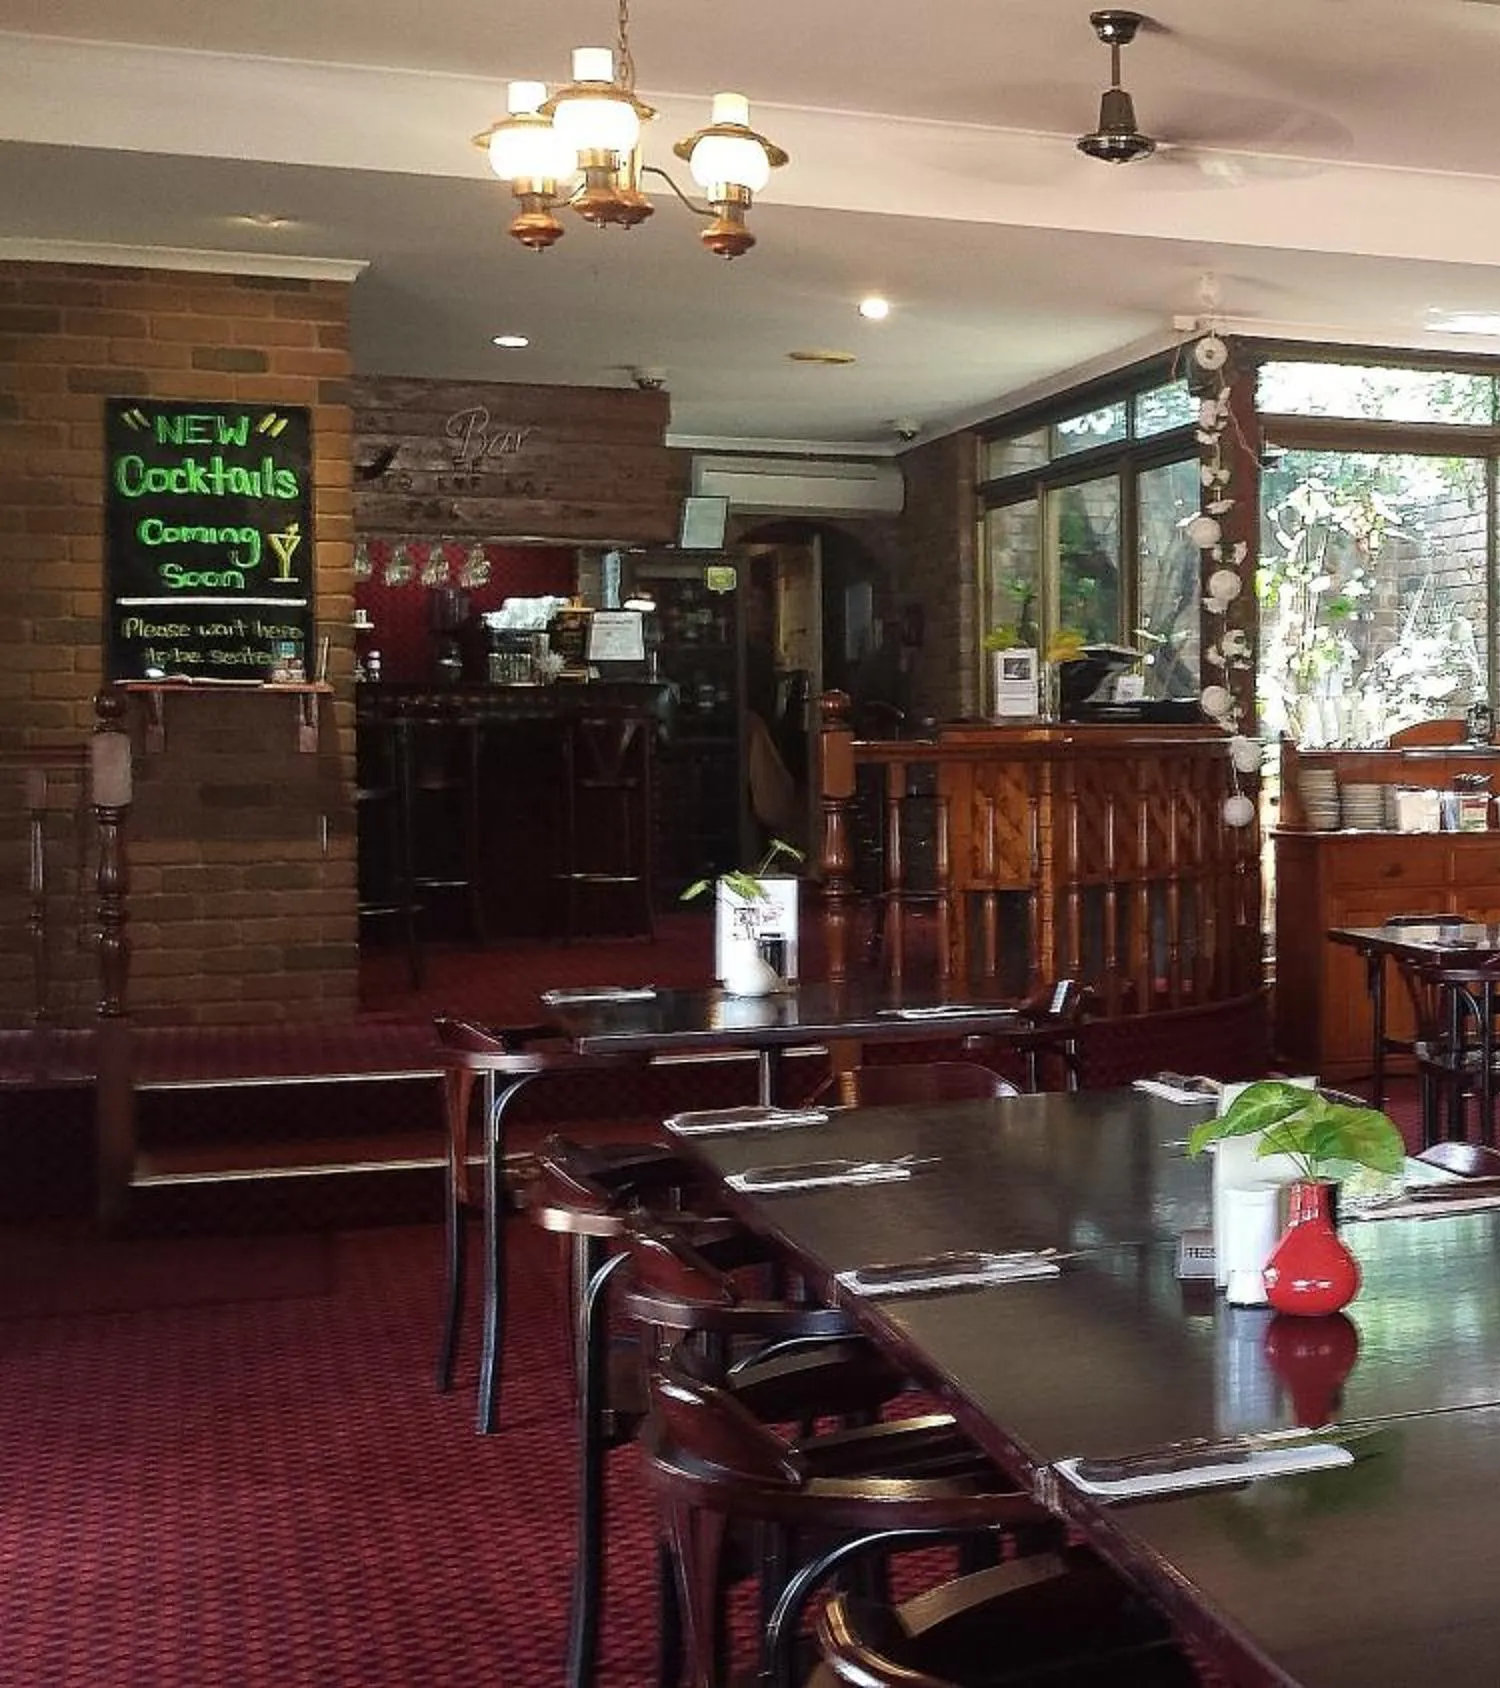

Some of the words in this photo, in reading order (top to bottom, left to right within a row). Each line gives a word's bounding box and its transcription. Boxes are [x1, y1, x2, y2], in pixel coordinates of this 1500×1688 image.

[446, 406, 541, 457] Bar
[115, 455, 299, 498] Cocktails
[138, 519, 261, 568] Coming
[161, 562, 245, 590] Soon
[122, 617, 190, 638] Please
[199, 619, 246, 638] wait
[255, 620, 304, 638] here
[173, 647, 204, 664] be
